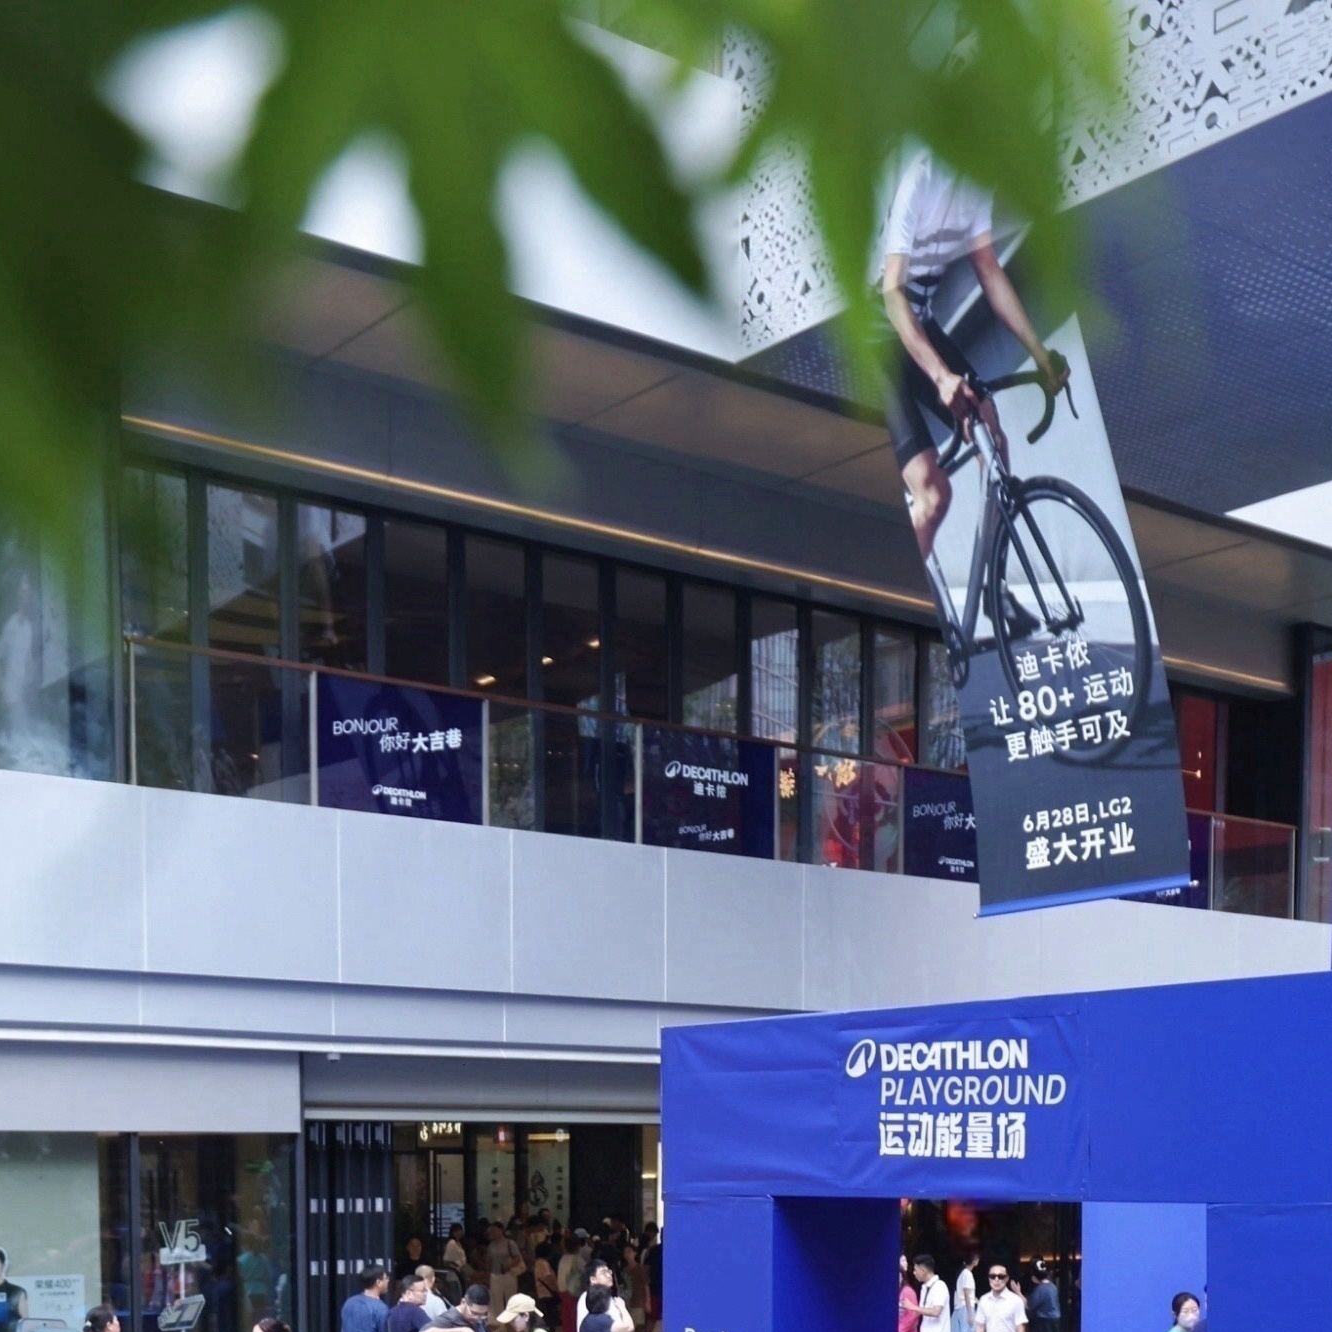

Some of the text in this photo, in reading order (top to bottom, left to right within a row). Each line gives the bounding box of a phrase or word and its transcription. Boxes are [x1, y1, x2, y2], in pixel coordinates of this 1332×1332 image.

[1016, 639, 1091, 682] 迪卡侬
[989, 667, 1135, 727] 让 80+ 运动
[333, 717, 399, 735] BONJOUR
[1004, 708, 1132, 763] 更触手可及
[682, 764, 749, 786] DECATHLON
[693, 780, 727, 798] 迪卡侬
[382, 786, 427, 800] DECATHLON
[913, 801, 957, 817] BONJOUR
[943, 814, 976, 831] 你好大
[1026, 821, 1136, 870] 盛大开业
[879, 1039, 1029, 1071] DECATHLON
[880, 1074, 1067, 1105] PLAYGROUND
[878, 1112, 1026, 1159] 运动能量场
